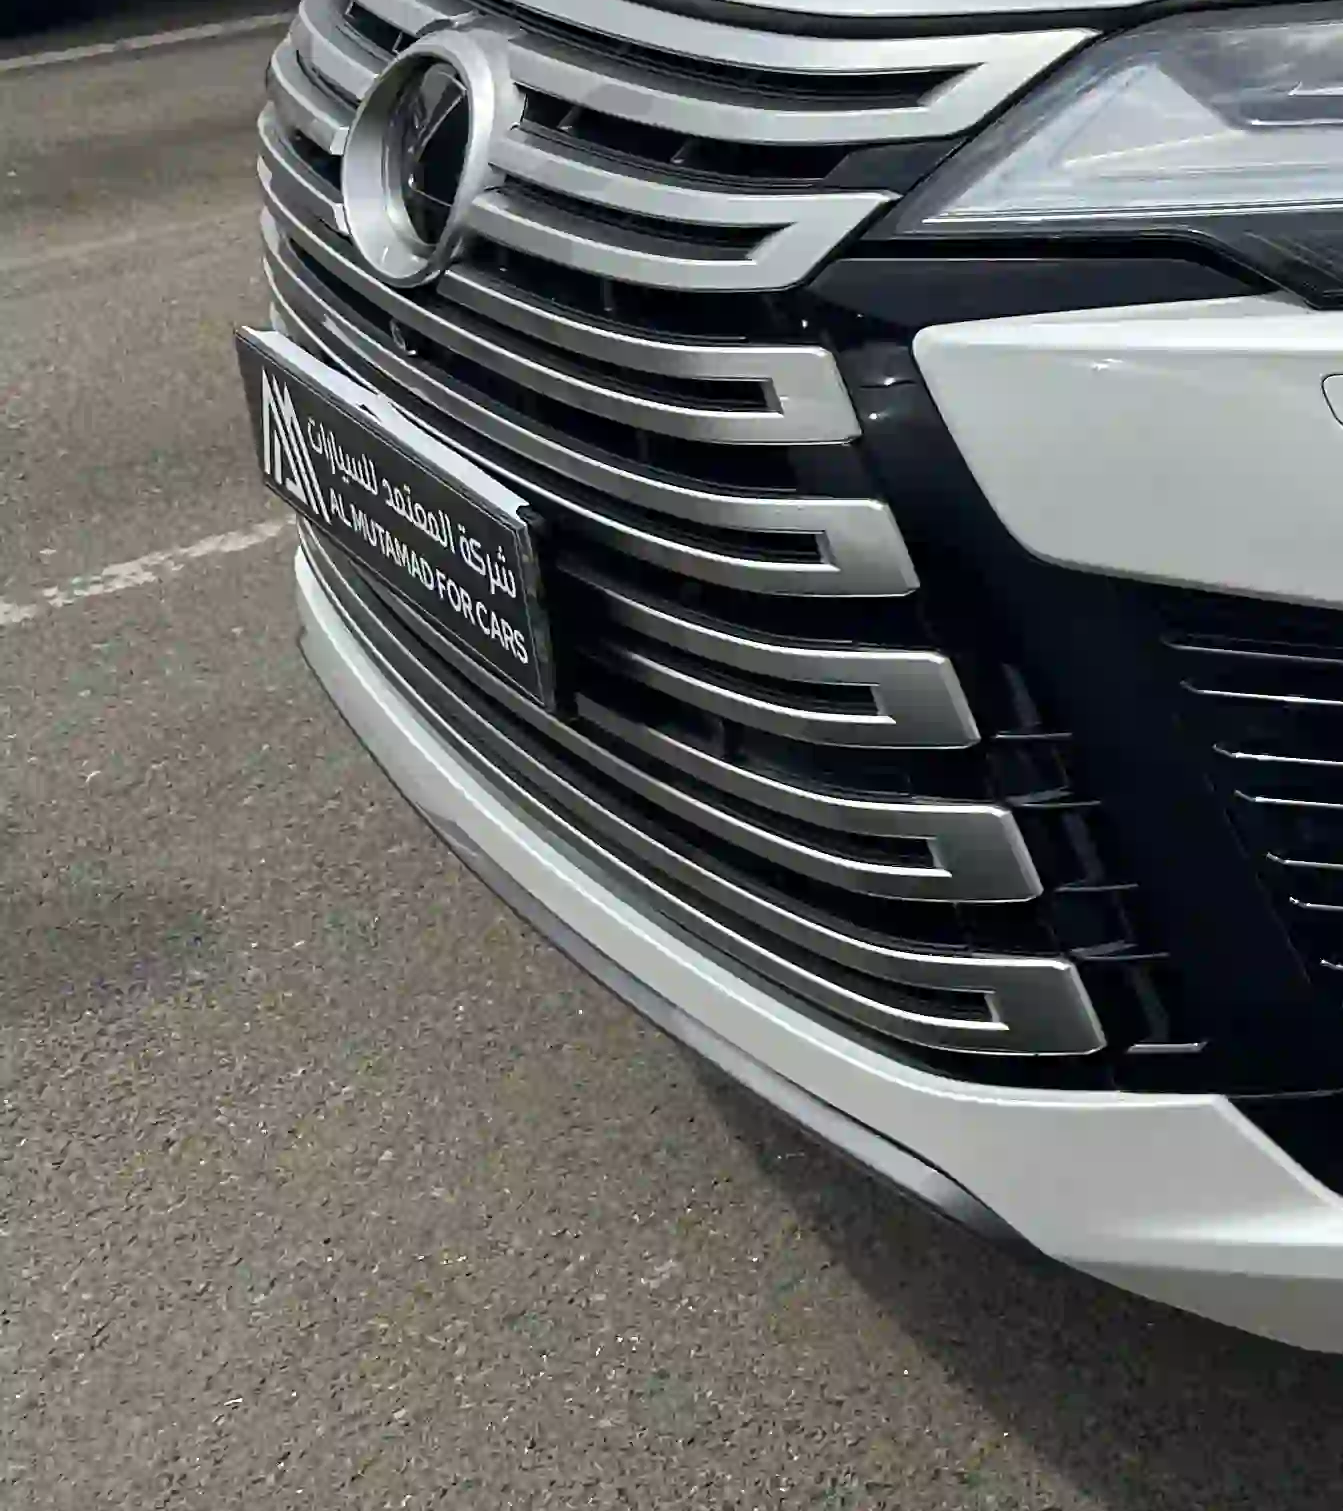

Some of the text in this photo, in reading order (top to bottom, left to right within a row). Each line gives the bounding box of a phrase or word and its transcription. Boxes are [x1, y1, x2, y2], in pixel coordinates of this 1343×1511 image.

[307, 416, 517, 599] شركة المعتمد للسيارات
[329, 487, 529, 665] AL MUTAMAD FOR CARS
